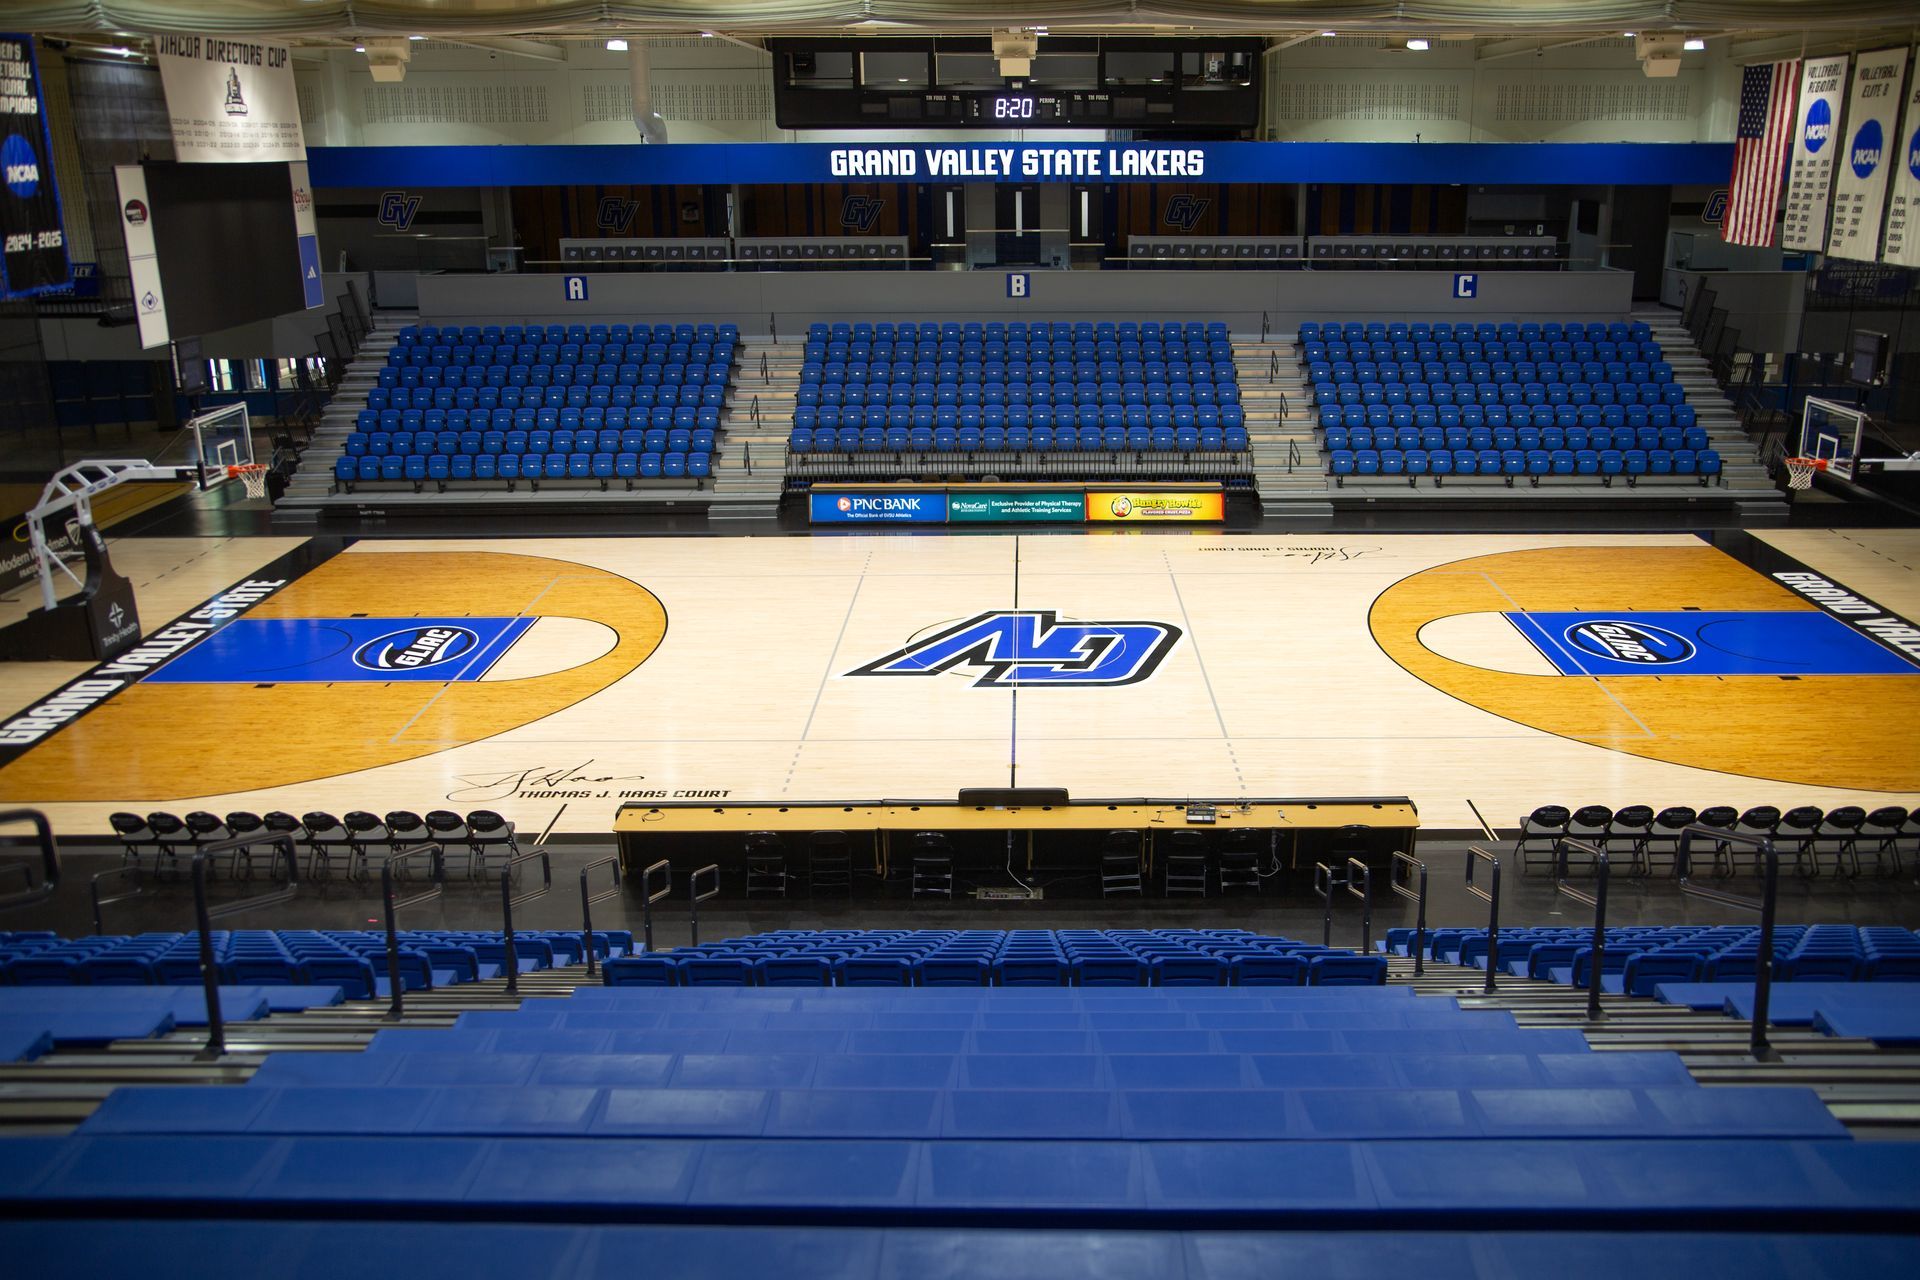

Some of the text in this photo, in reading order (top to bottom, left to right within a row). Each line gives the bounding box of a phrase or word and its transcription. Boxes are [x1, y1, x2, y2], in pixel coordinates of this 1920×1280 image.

[0, 42, 21, 60] EN'S
[268, 46, 287, 68] CUP
[1808, 63, 1843, 78] VOLLEYBALL
[1860, 64, 1899, 80] VOLLEYBALL
[0, 78, 28, 96] IONAL
[1808, 79, 1838, 93] REGIONAL
[1862, 84, 1883, 98] ELITE
[995, 98, 1033, 118] 8:20
[1805, 125, 1830, 140] NCAA
[831, 150, 1204, 176] GRAND VALLEY STATE LAKERS
[1853, 150, 1880, 165] NCAA
[7, 164, 40, 183] NCAA
[378, 191, 423, 231] GV
[597, 196, 640, 235] GV
[840, 195, 886, 233] GV
[1164, 194, 1212, 231] GV
[74, 266, 91, 277] LEY
[569, 278, 584, 300] A
[1012, 274, 1026, 296] B
[1458, 276, 1472, 296] C
[853, 498, 920, 510] PNC BANK
[1133, 499, 1166, 509] Hungry
[0, 552, 30, 574] Modern
[1772, 572, 1881, 614] GRAND
[102, 622, 138, 648] Trinity Health
[1590, 624, 1658, 662] GLIAC
[395, 628, 453, 666] GLIAC
[0, 579, 287, 744] GRAND VALLEY STATE
[518, 790, 732, 798] THOMAS J. HAAS COURT
